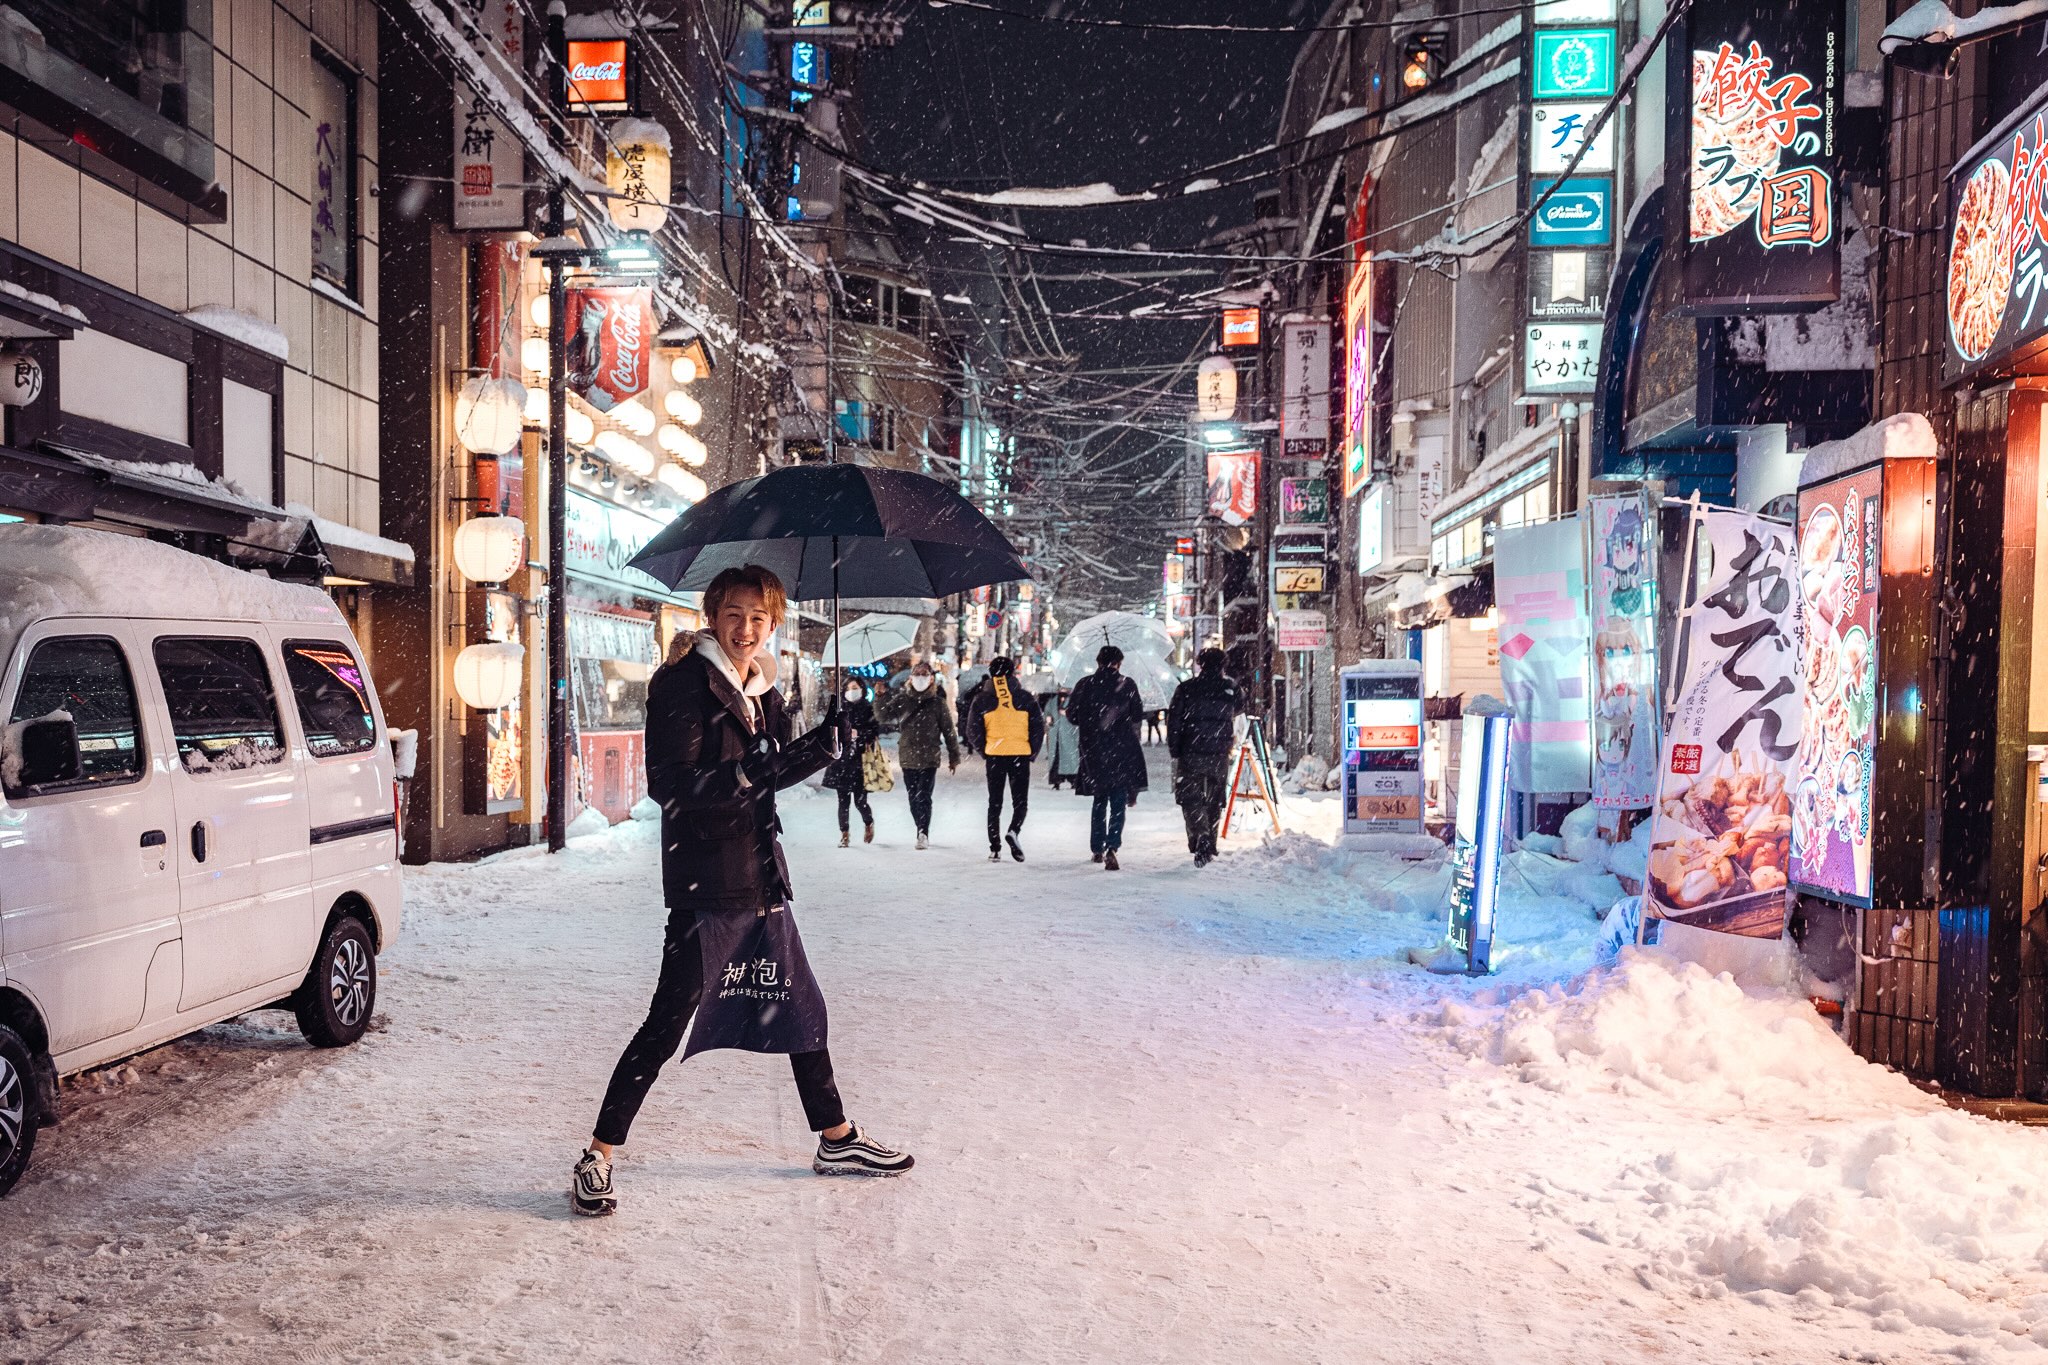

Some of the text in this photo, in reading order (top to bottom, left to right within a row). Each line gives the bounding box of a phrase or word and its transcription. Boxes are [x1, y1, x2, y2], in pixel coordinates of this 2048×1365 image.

[622, 145, 645, 219] 虎屋横丁
[1545, 340, 1588, 350] 小料理
[1531, 357, 1601, 378] やかた
[1702, 528, 1800, 763] おでん
[720, 958, 792, 988] 神泡。
[718, 987, 790, 1001] 神泡は当店でどうぞ。
